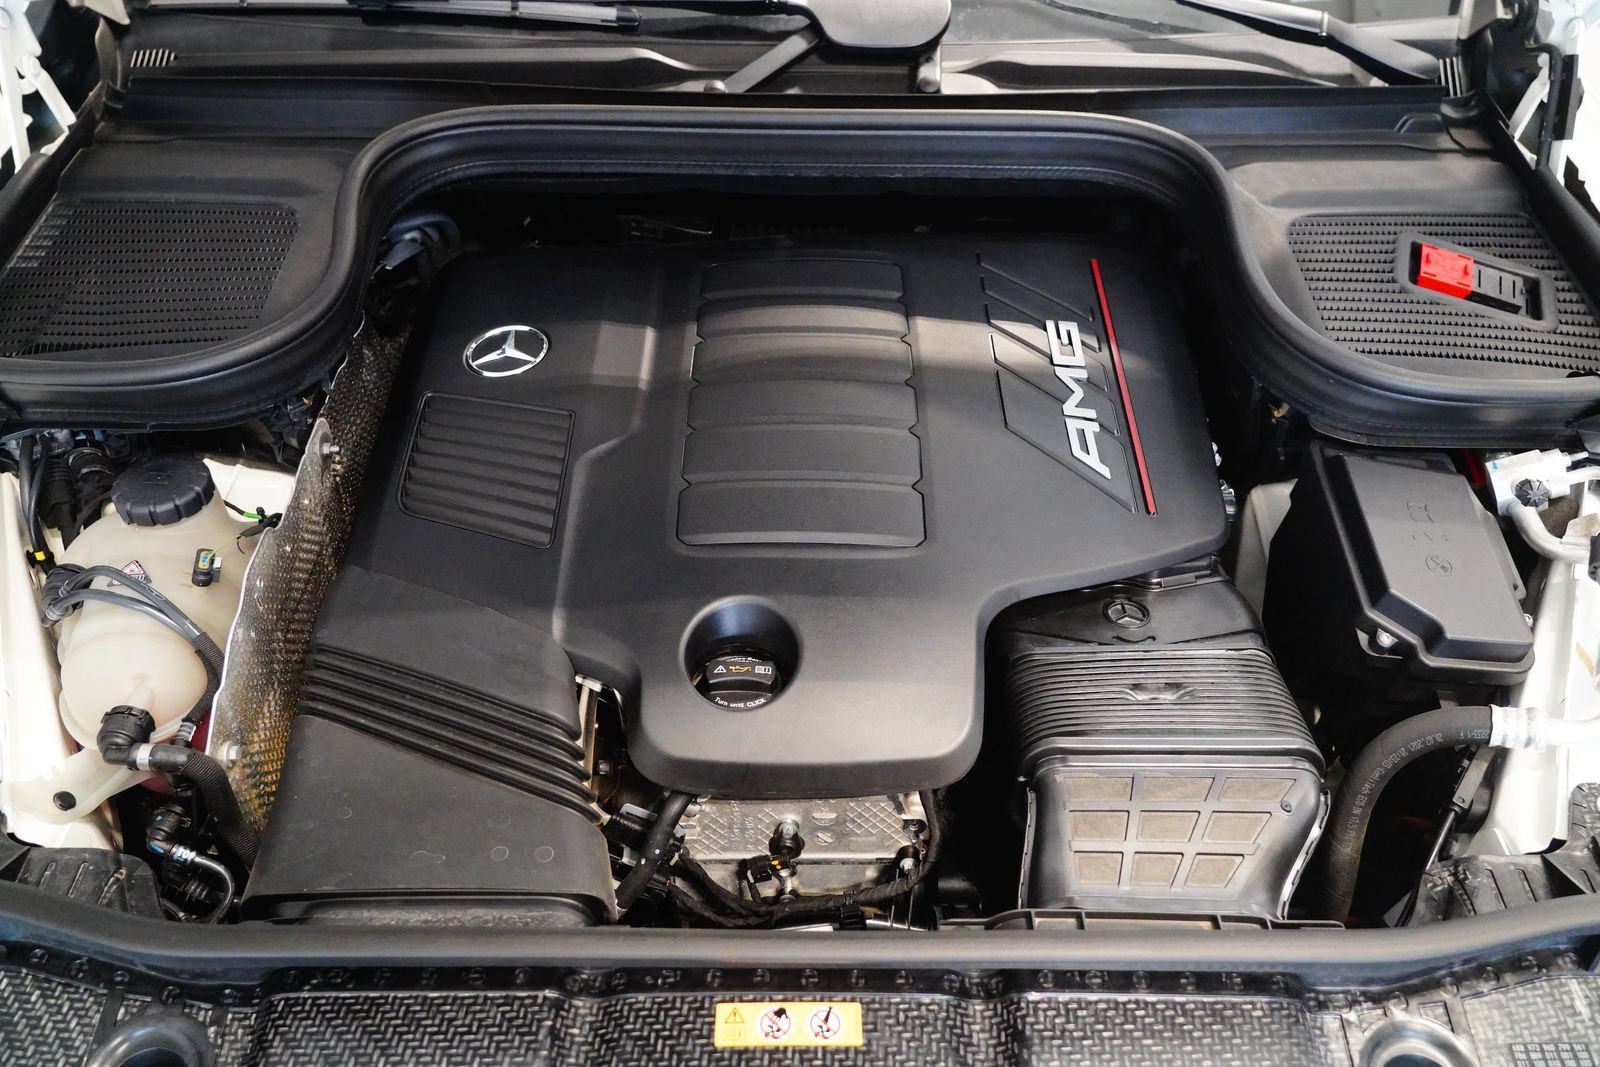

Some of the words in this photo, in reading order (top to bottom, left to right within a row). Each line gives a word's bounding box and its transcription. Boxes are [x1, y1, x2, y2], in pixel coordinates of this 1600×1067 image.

[1046, 320, 1112, 480] AMG
[714, 697, 728, 706] Turn
[747, 698, 766, 708] CLICK
